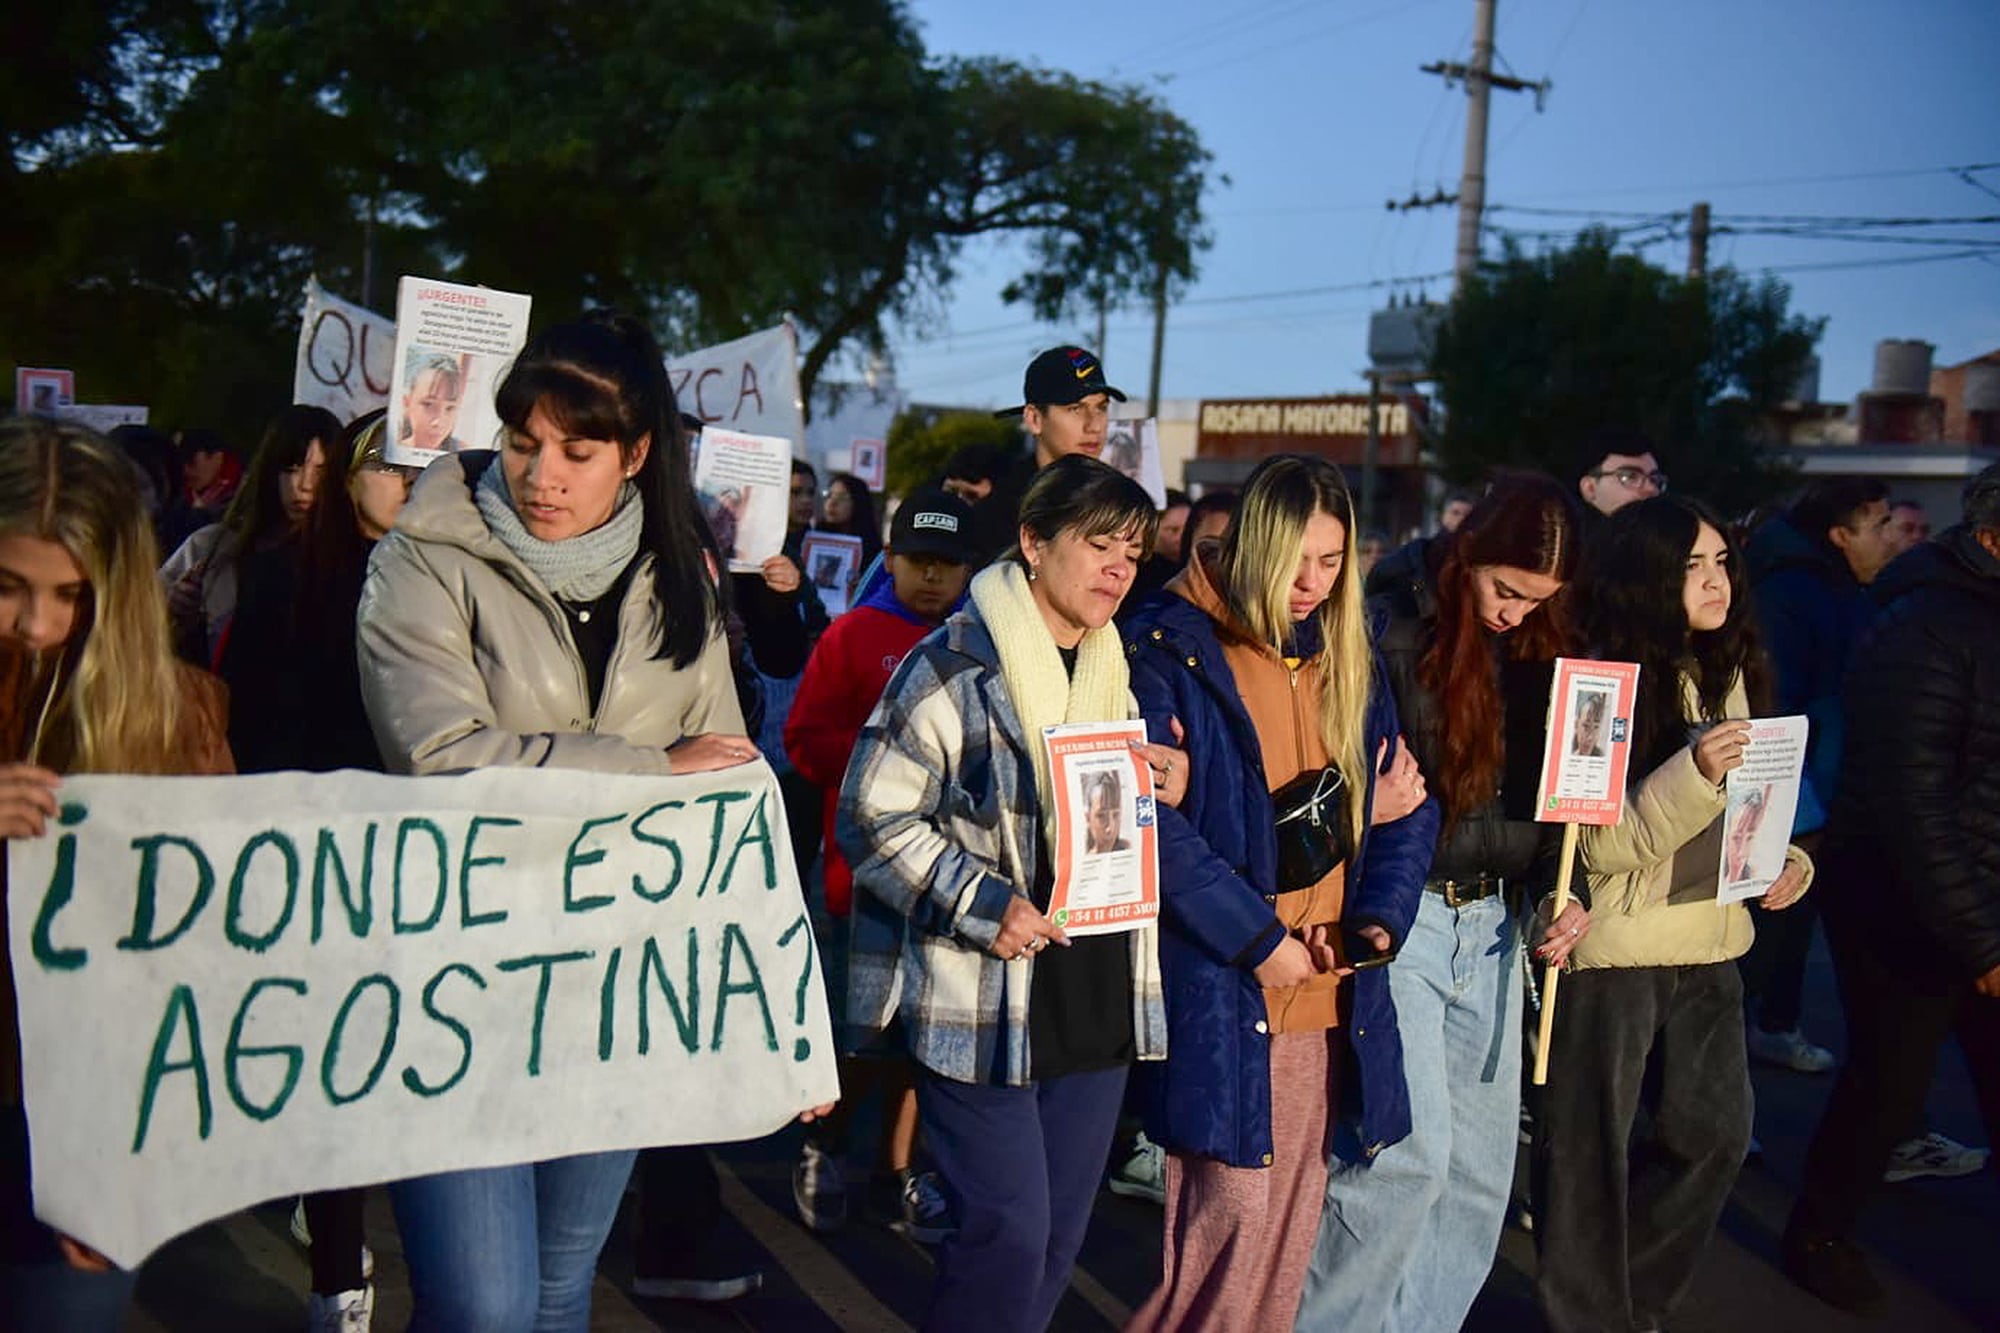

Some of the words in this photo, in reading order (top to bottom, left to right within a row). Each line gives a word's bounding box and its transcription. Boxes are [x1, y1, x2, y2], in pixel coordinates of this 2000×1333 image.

[32, 801, 523, 972] ¿DONDE
[564, 790, 777, 912] ESTA
[131, 914, 813, 1154] AGOSTINA?
